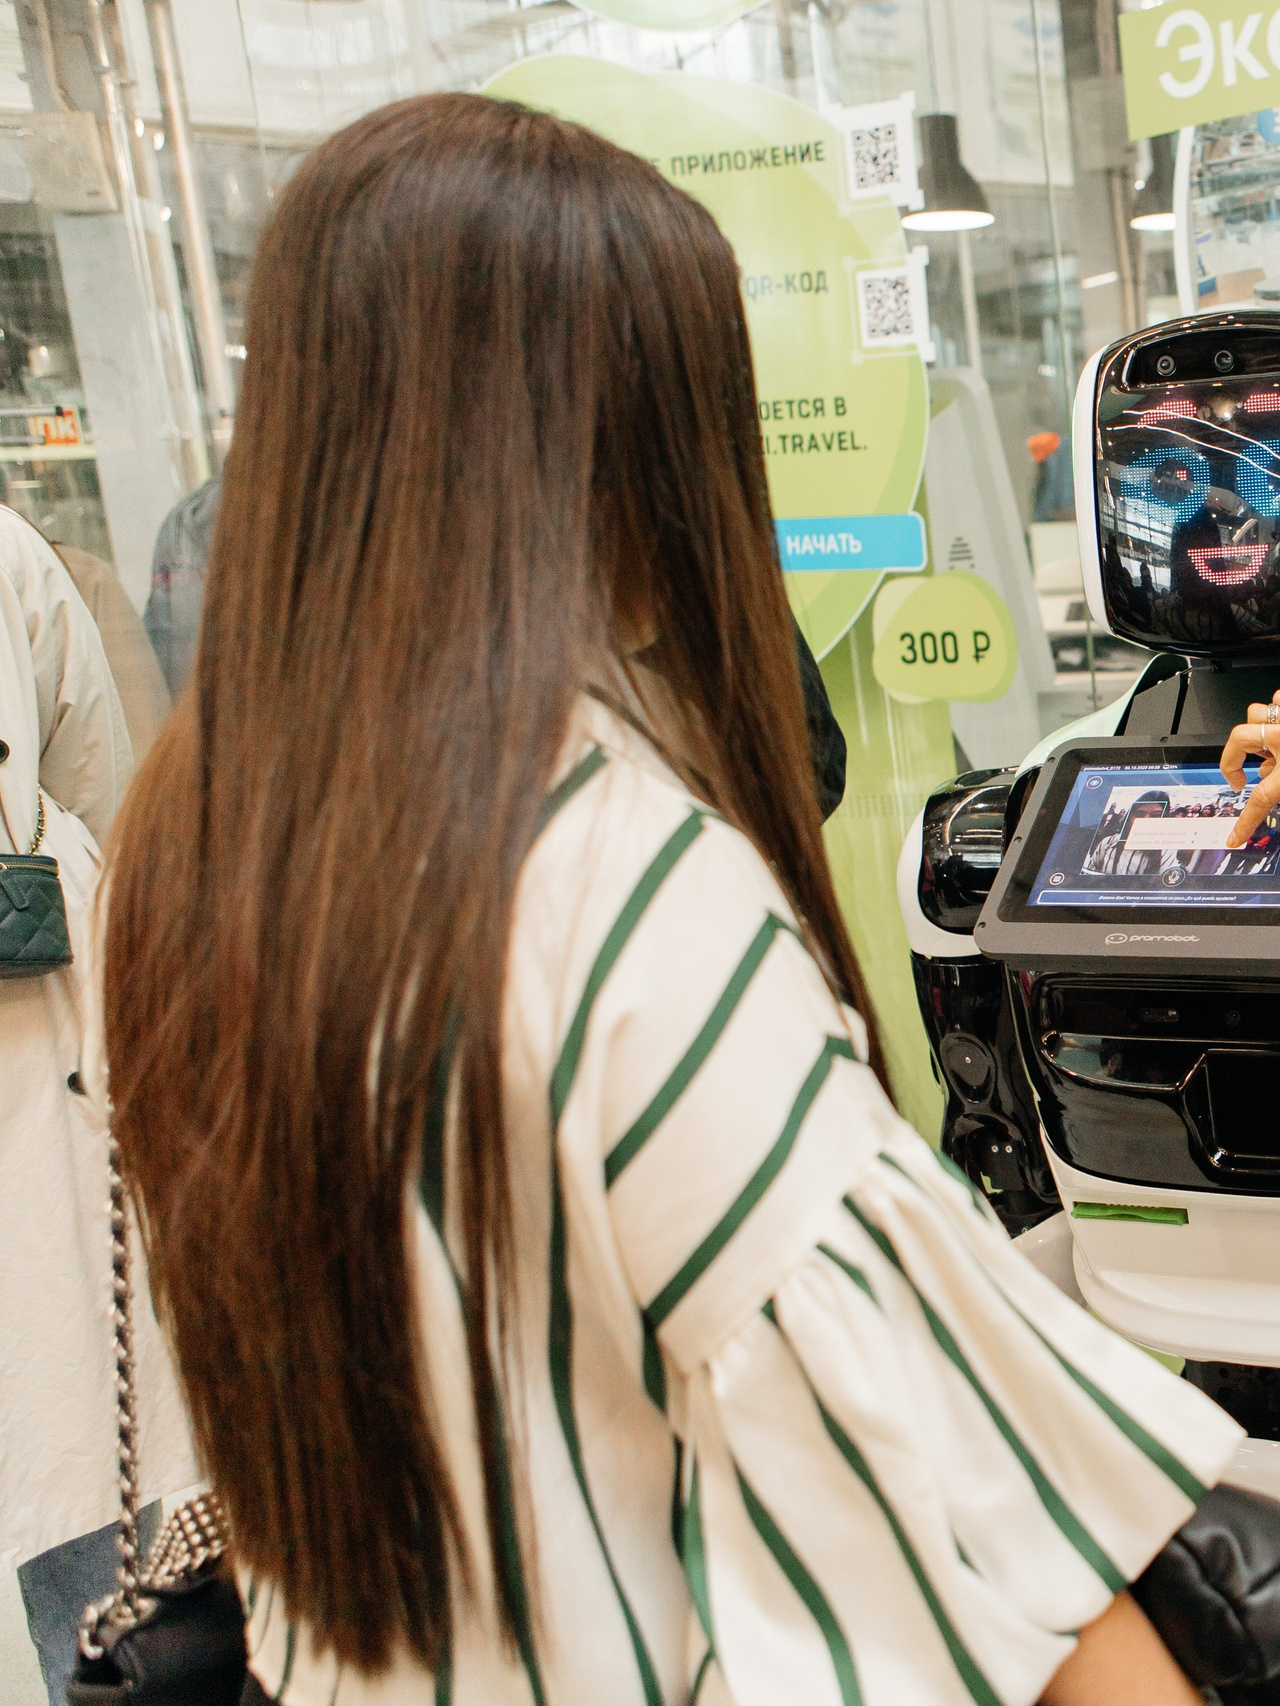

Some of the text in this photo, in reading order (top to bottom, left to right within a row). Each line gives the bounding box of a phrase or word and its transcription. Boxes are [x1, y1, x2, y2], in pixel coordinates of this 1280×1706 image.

[671, 141, 826, 176] ПРИЛОЖЕНИЕ
[744, 270, 829, 300] QR-КОД
[834, 397, 848, 416] В
[786, 533, 862, 556] НАЧАТЬ
[900, 631, 959, 664] 300
